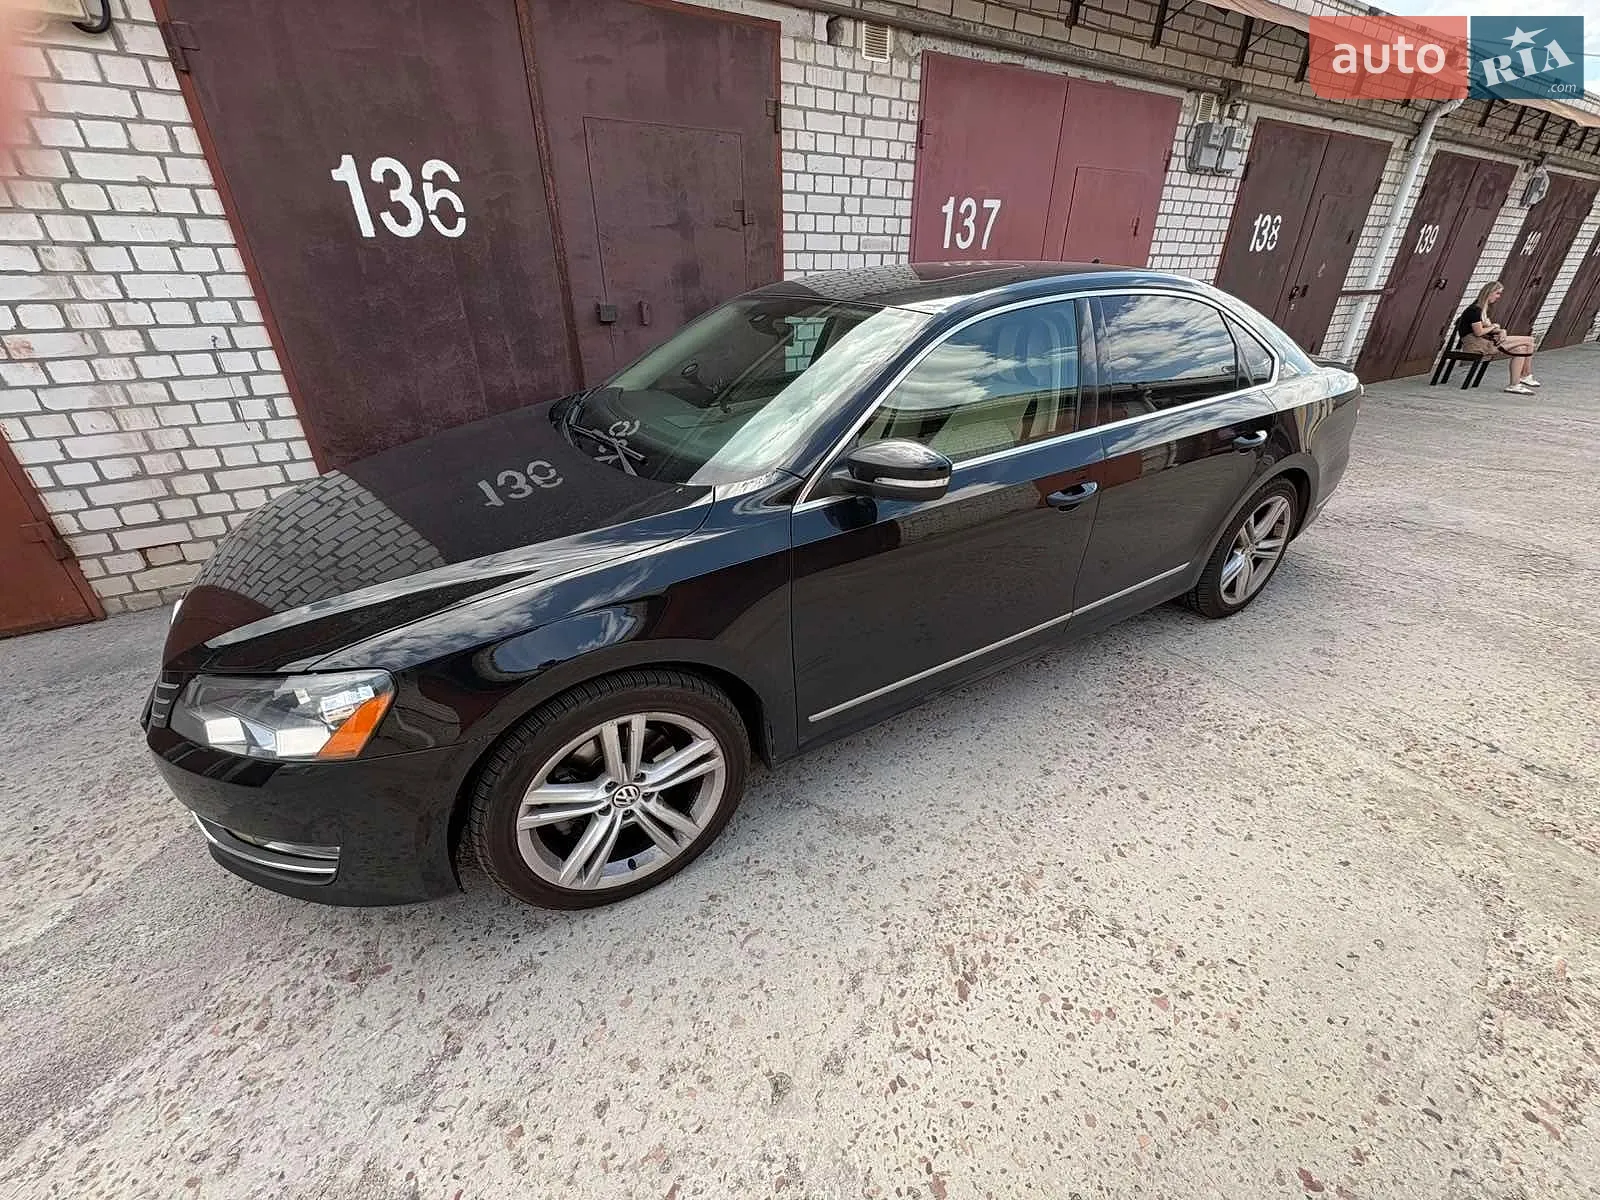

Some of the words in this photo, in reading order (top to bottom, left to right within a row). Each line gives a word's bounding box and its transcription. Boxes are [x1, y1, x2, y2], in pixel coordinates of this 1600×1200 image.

[330, 154, 466, 238] 136
[942, 196, 1001, 250] 137
[1249, 213, 1282, 252] 138
[1414, 223, 1440, 254] 139
